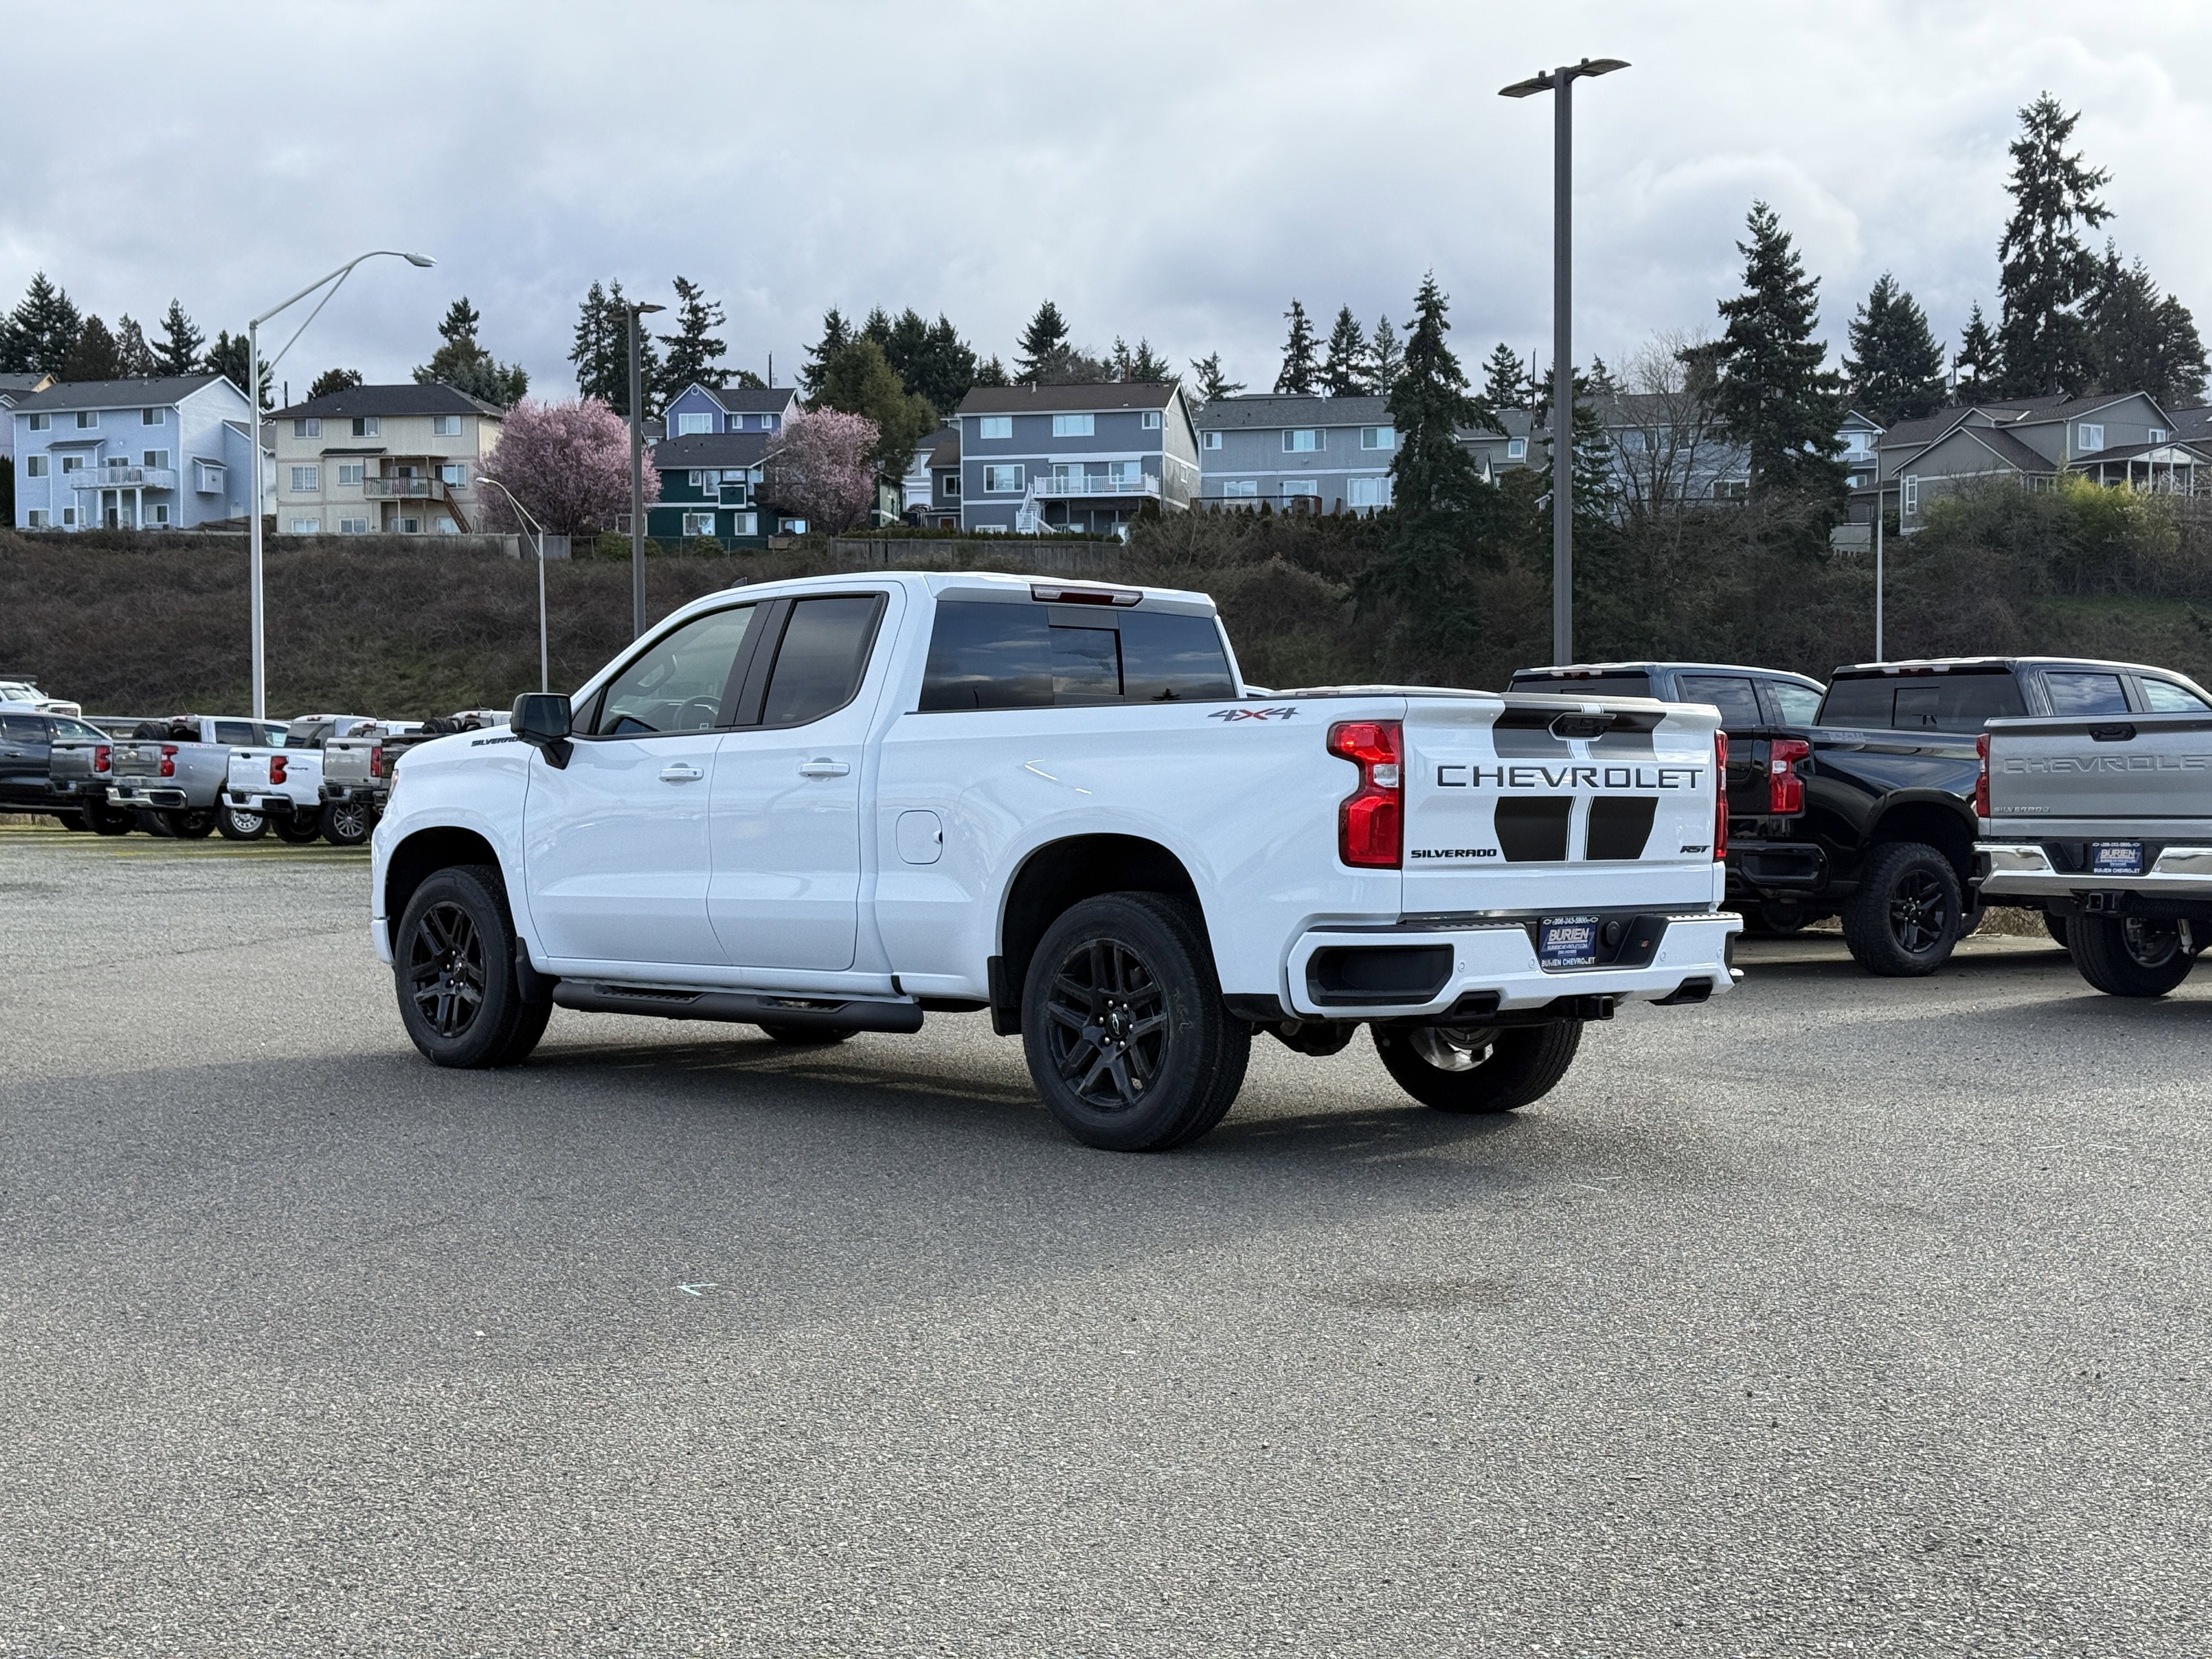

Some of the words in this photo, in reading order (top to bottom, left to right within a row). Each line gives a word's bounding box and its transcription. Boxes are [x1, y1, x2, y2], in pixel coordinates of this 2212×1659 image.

[471, 736, 518, 747] SILVERAD
[2004, 754, 2212, 774] CHEVROLE
[1437, 765, 1704, 789] CHEVROLET
[1410, 849, 1497, 859] SILVERADO
[1680, 845, 1711, 854] RST
[2101, 849, 2136, 858] BURIEN
[1549, 928, 1590, 941] BURIEN
[1542, 959, 1561, 967] BURIEN
[1562, 957, 1596, 966] CHEVROLET
